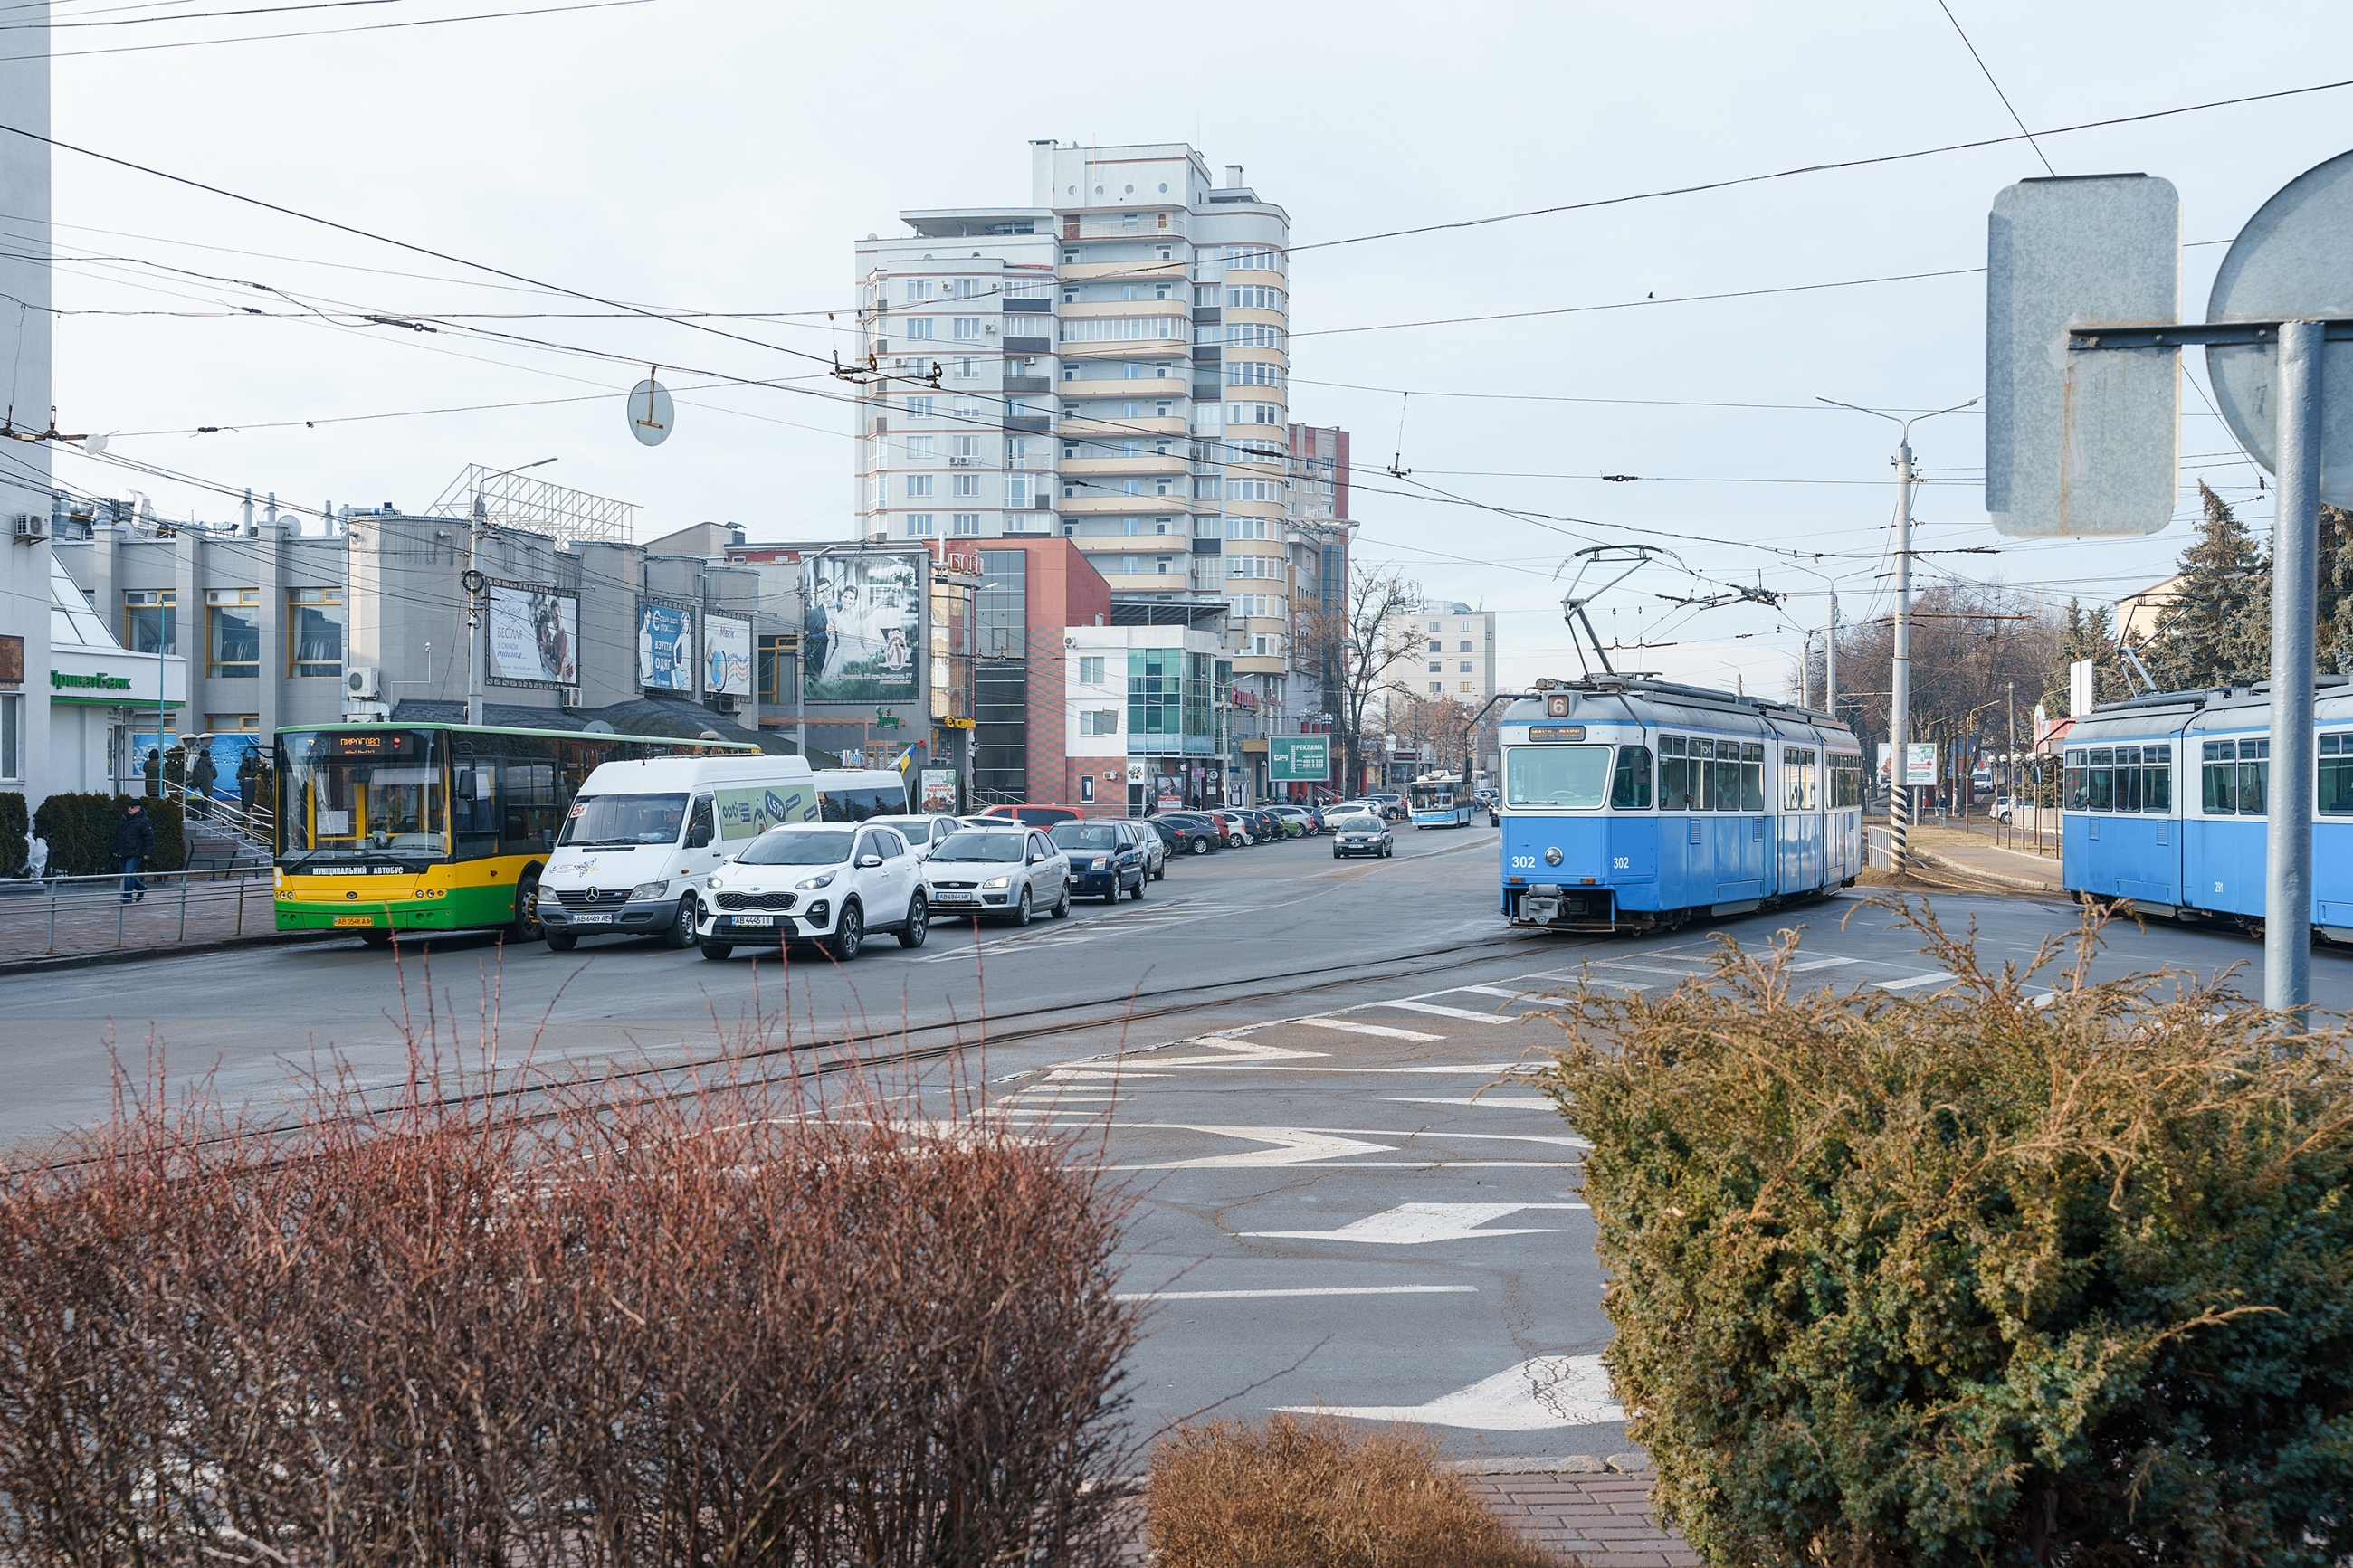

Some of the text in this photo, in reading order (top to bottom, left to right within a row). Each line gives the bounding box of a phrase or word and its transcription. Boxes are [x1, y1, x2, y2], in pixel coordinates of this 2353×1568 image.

[497, 627, 523, 641] ВЕСІЛЛЯ
[654, 640, 672, 651] ВЗУТТЯ
[654, 657, 672, 672] ОДЯГ
[50, 670, 132, 690] ПриватБанк
[1552, 698, 1565, 714] 6
[722, 801, 739, 821] opti
[772, 802, 784, 819] 579
[1511, 856, 1536, 868] 302
[1613, 857, 1629, 869] 302
[312, 866, 404, 877] МУНІЦИПАЛЬНИЙ АВТОБУС
[348, 917, 361, 926] 0548
[362, 917, 371, 926] AA
